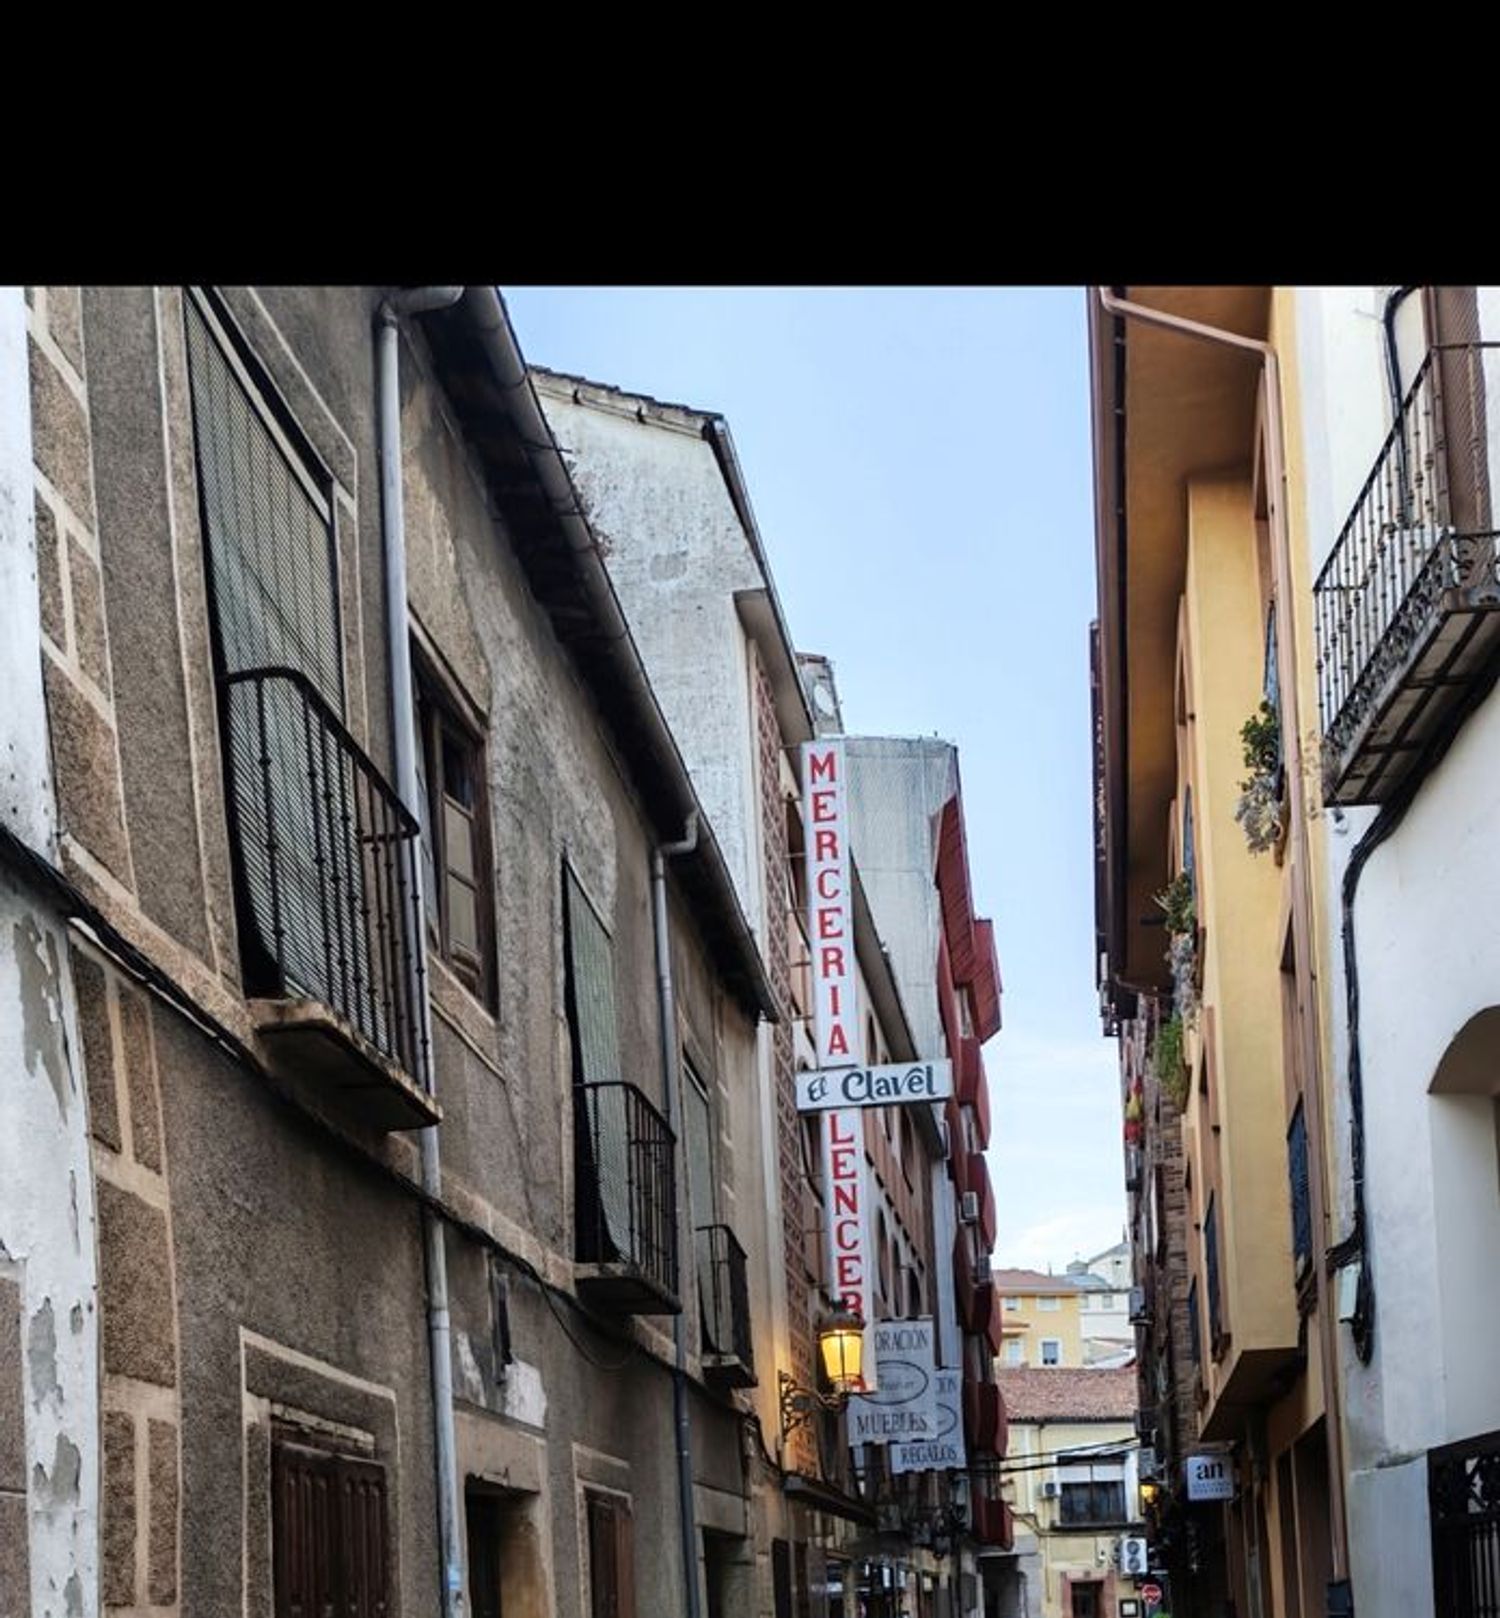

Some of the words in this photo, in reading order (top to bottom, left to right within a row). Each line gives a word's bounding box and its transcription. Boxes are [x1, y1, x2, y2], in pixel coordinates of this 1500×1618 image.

[809, 751, 849, 1056] MERCERIA
[807, 1075, 829, 1102] El
[856, 1411, 929, 1435] MUEBLES
[900, 1444, 957, 1464] REGALOS
[1196, 1462, 1224, 1480] an
